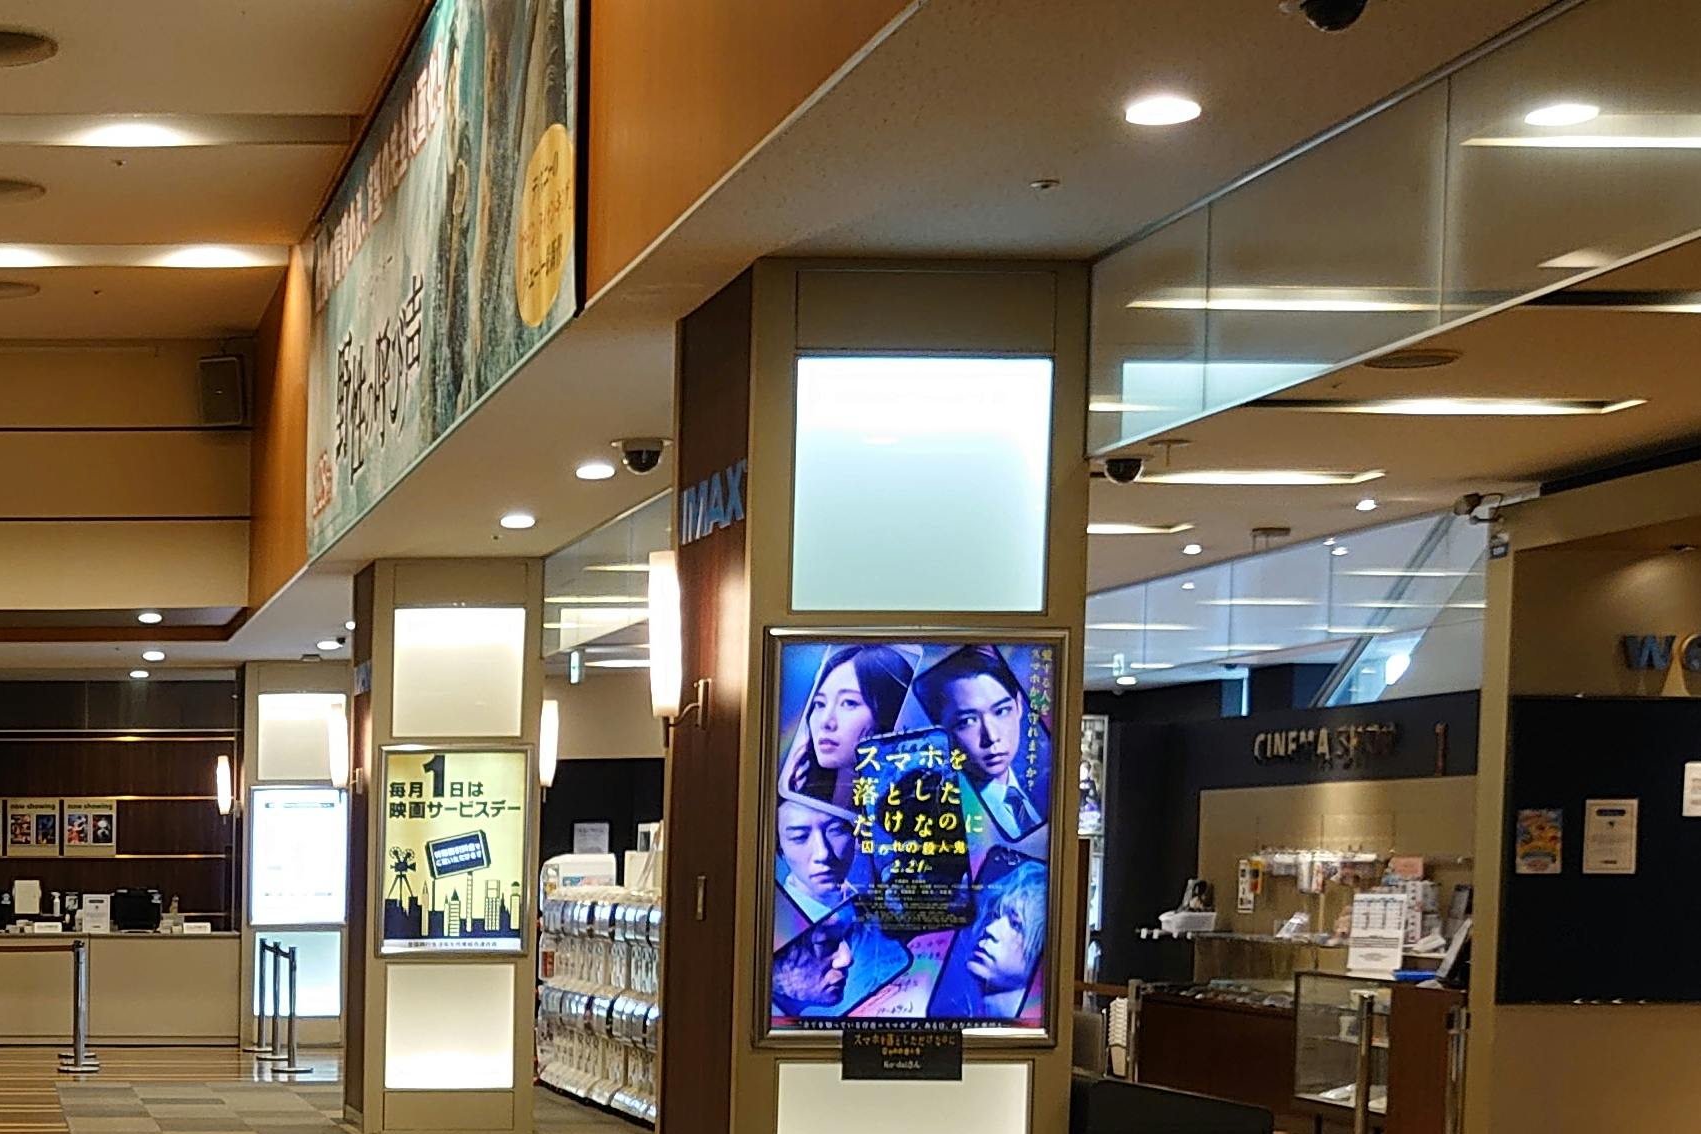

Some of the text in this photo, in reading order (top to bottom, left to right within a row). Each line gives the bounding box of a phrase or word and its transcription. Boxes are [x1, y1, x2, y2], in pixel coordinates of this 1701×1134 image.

[681, 457, 748, 545] IMAX
[854, 744, 968, 772] スマホを
[389, 754, 484, 799] 毎月1日は
[852, 776, 961, 807] 落とした
[389, 799, 522, 819] 映画サービスデー
[852, 810, 984, 838] だけなのに
